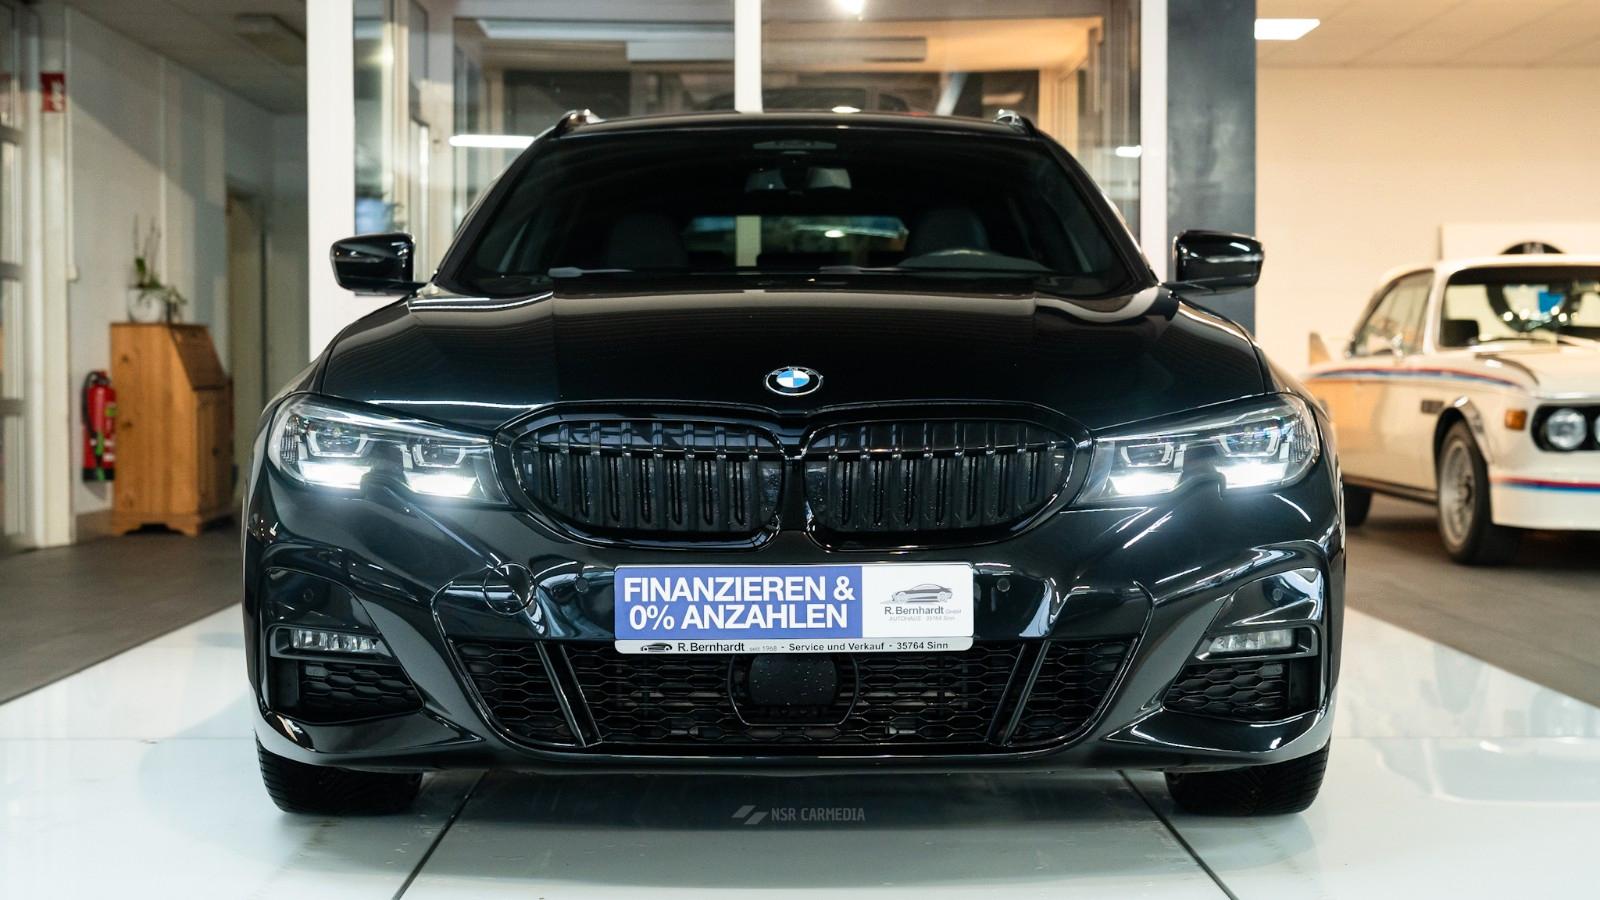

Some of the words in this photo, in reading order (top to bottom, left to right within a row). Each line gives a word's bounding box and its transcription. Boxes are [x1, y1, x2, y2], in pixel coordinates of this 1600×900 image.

[623, 575, 826, 602] FINANZIEREN
[833, 575, 856, 601] &
[629, 604, 675, 630] 0%
[681, 603, 848, 629] ANZAHLEN
[788, 642, 824, 651] Service
[827, 642, 846, 651] und
[848, 642, 885, 651] Verkauf
[896, 641, 925, 650] 35764
[927, 641, 949, 650] Sinn
